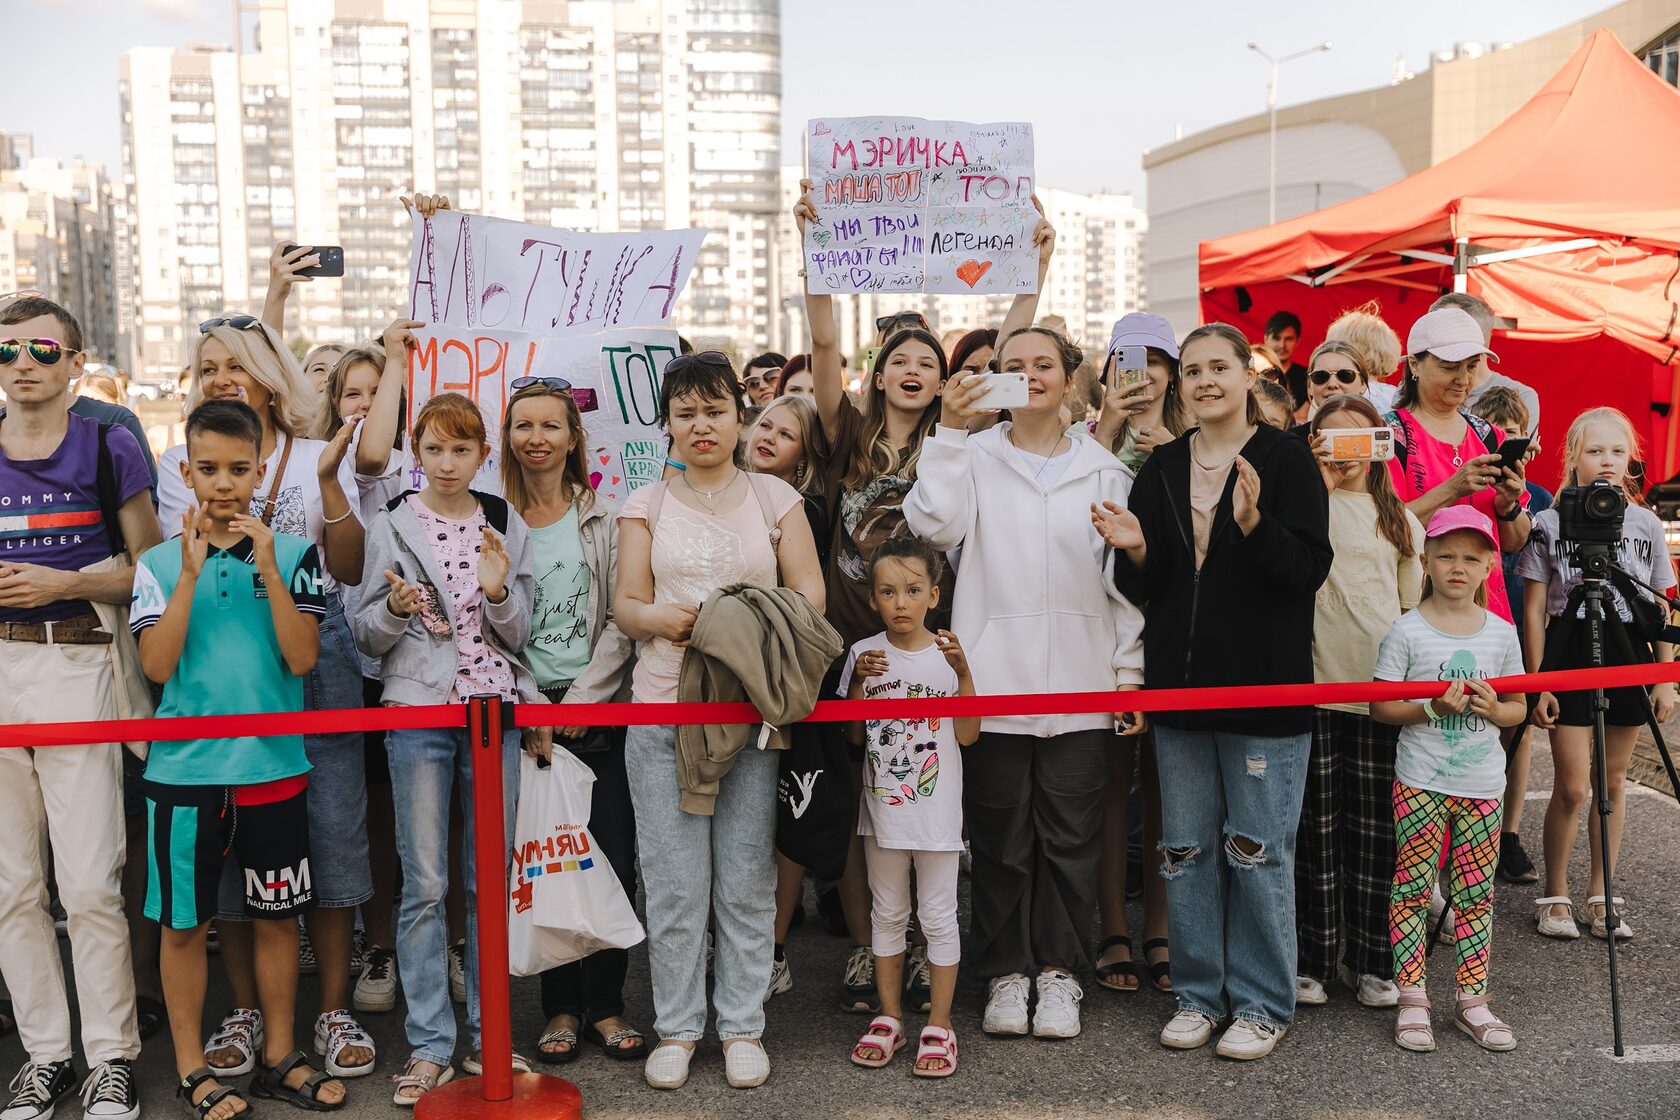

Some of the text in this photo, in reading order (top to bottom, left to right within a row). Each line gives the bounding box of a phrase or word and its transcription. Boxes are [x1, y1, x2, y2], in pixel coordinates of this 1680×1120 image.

[832, 136, 968, 171] МЭРИЧКА
[825, 169, 923, 206] МАША ТОП
[959, 174, 1032, 203] ТОП
[833, 213, 920, 242] МЫ ТВОИ
[540, 586, 589, 630] just
[1591, 619, 1599, 640] SLIK
[246, 890, 312, 911] NAUTICAL MILE
